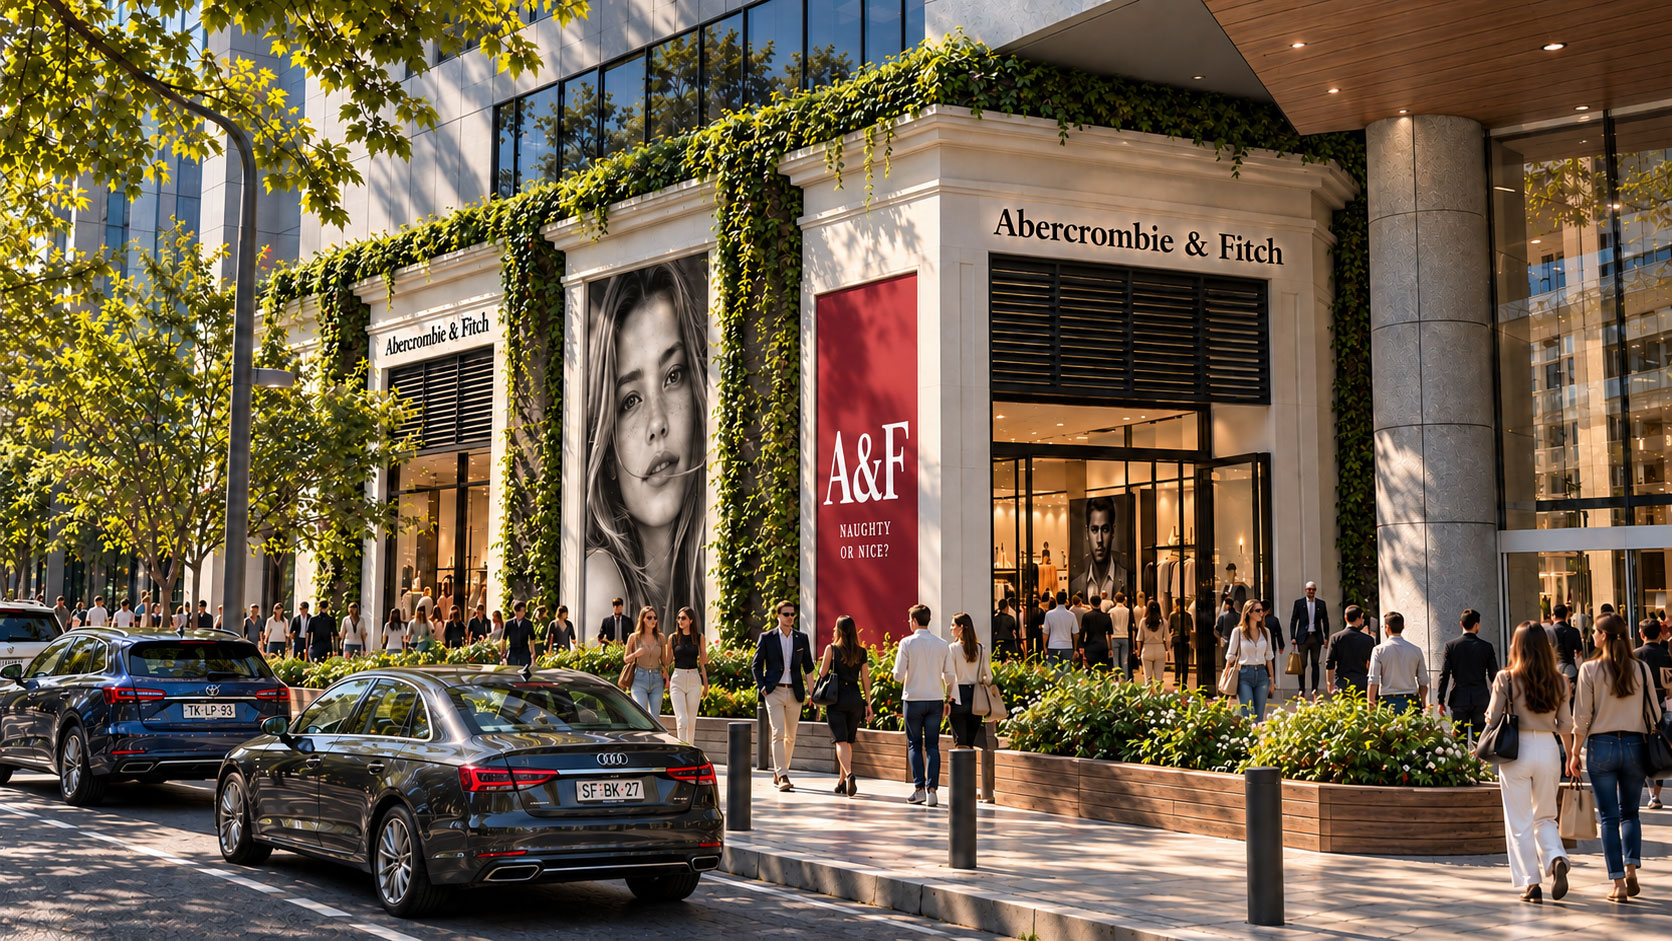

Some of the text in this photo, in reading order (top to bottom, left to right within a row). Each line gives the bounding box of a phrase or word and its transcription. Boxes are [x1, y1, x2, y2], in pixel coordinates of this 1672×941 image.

[993, 208, 1284, 266] Abercrombie & Fitch
[385, 311, 490, 357] Abercrombie & Fitch
[823, 420, 909, 506] A&F
[839, 520, 891, 539] NAUGHTY
[840, 543, 889, 560] OR NICE?
